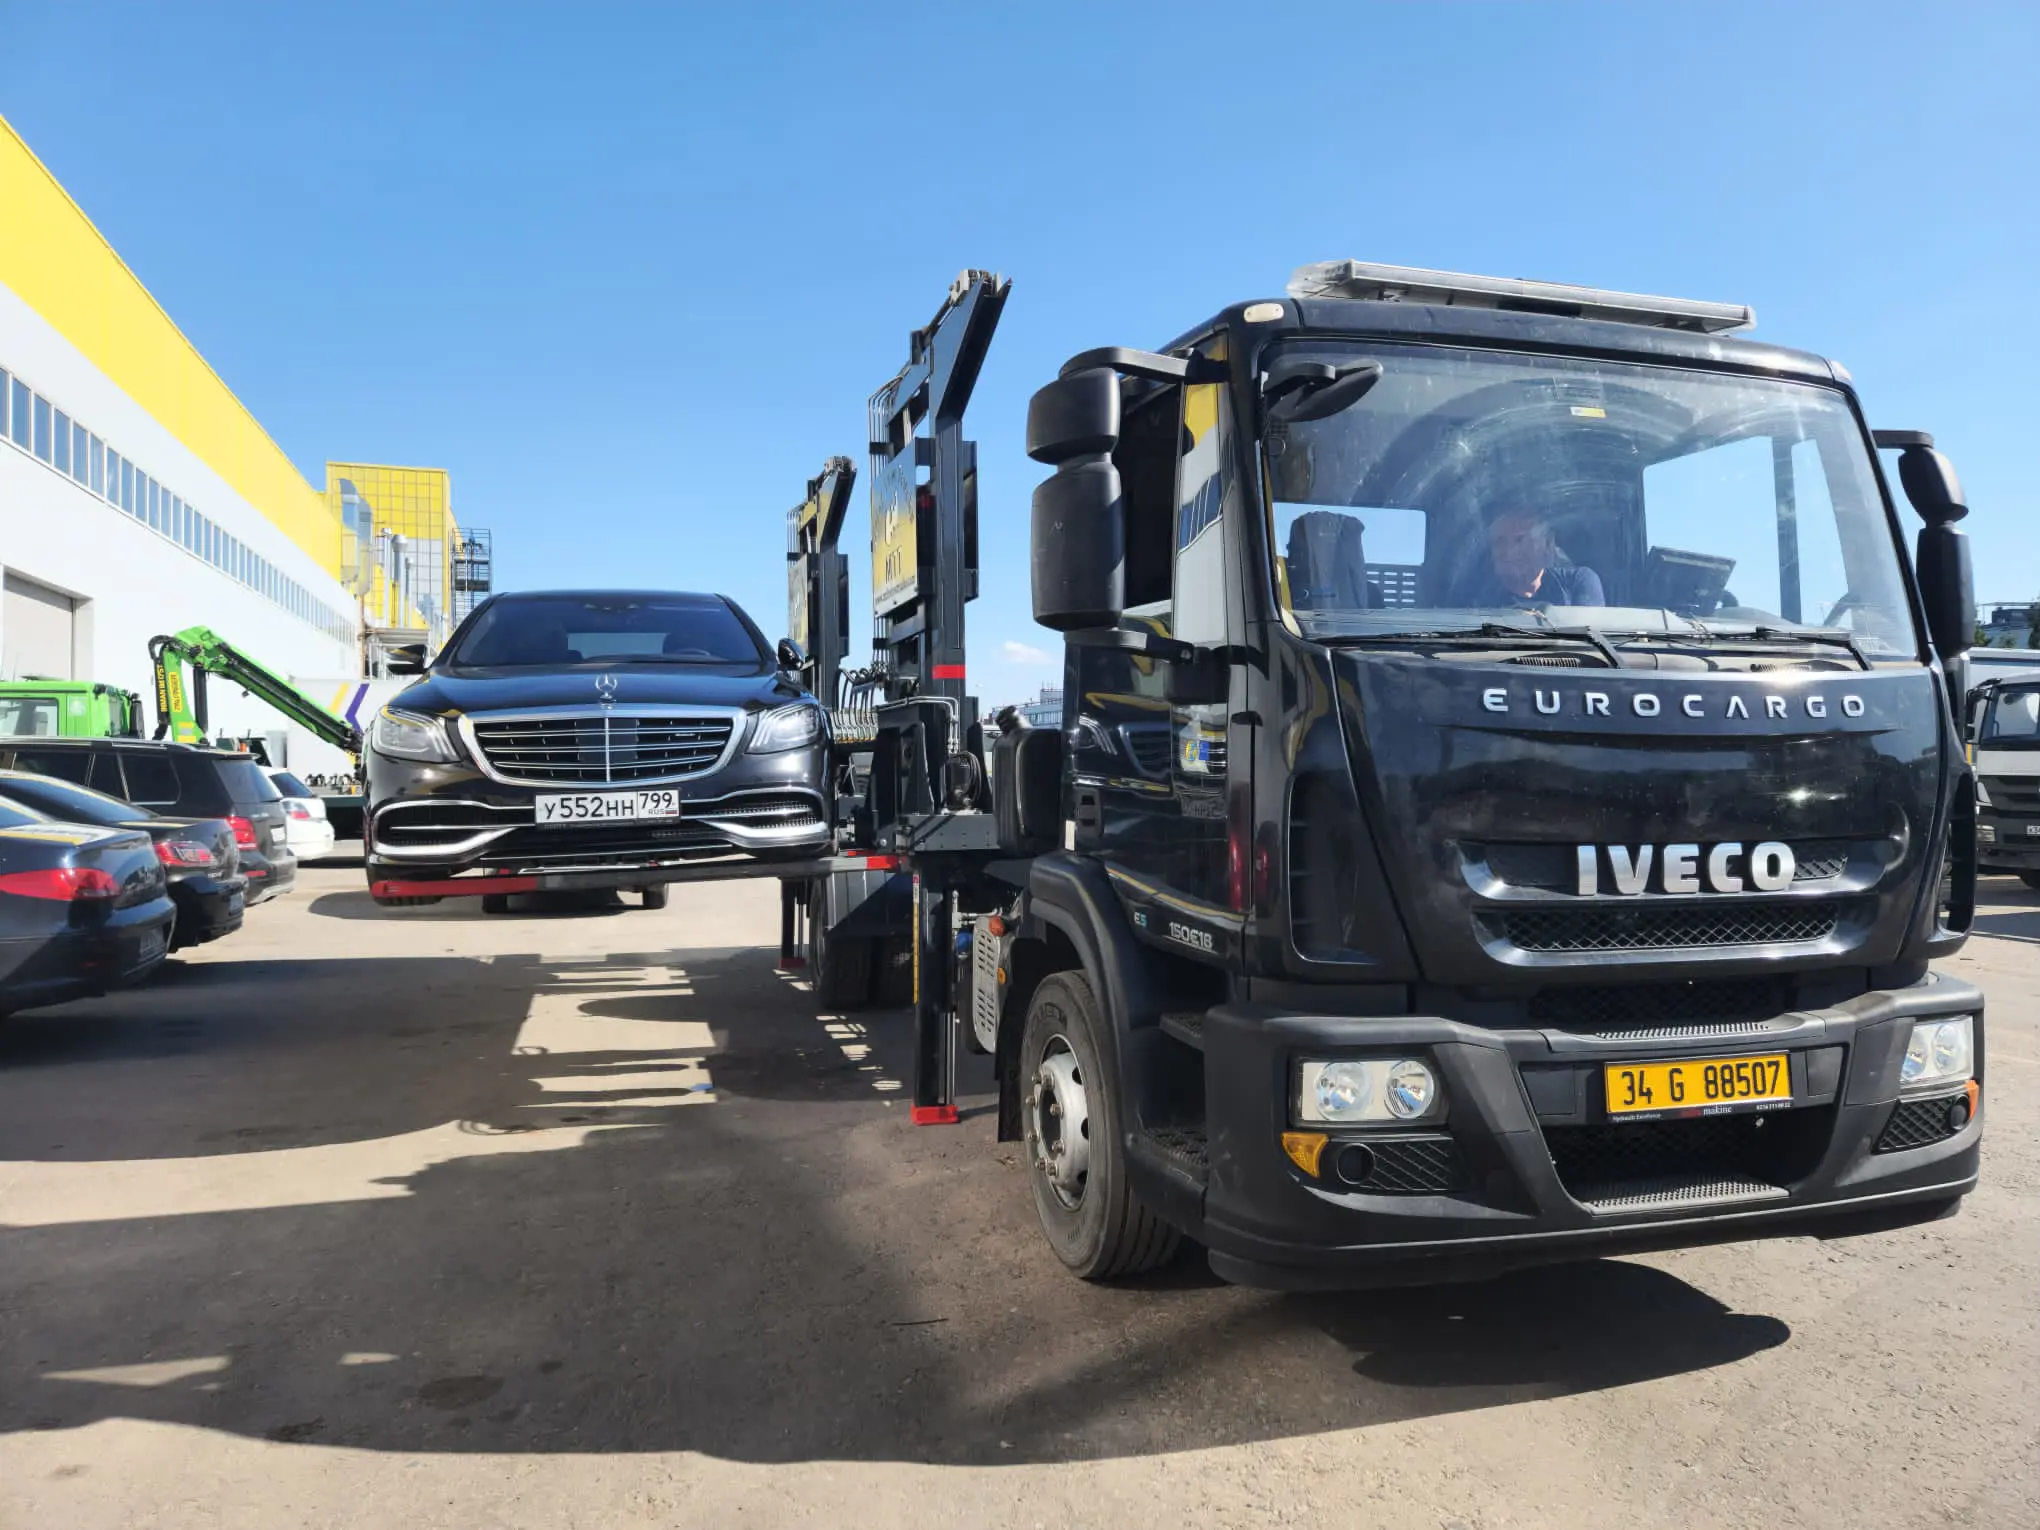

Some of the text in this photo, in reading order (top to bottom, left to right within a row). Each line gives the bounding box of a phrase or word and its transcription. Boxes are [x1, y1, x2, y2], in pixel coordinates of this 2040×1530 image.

[1483, 688, 1865, 719] EUROCARGO
[544, 796, 635, 820] У552НН
[639, 792, 673, 810] 799
[648, 808, 665, 816] RUS
[1577, 841, 1796, 896] IVECO
[1621, 1060, 1781, 1106] 34 G 88507
